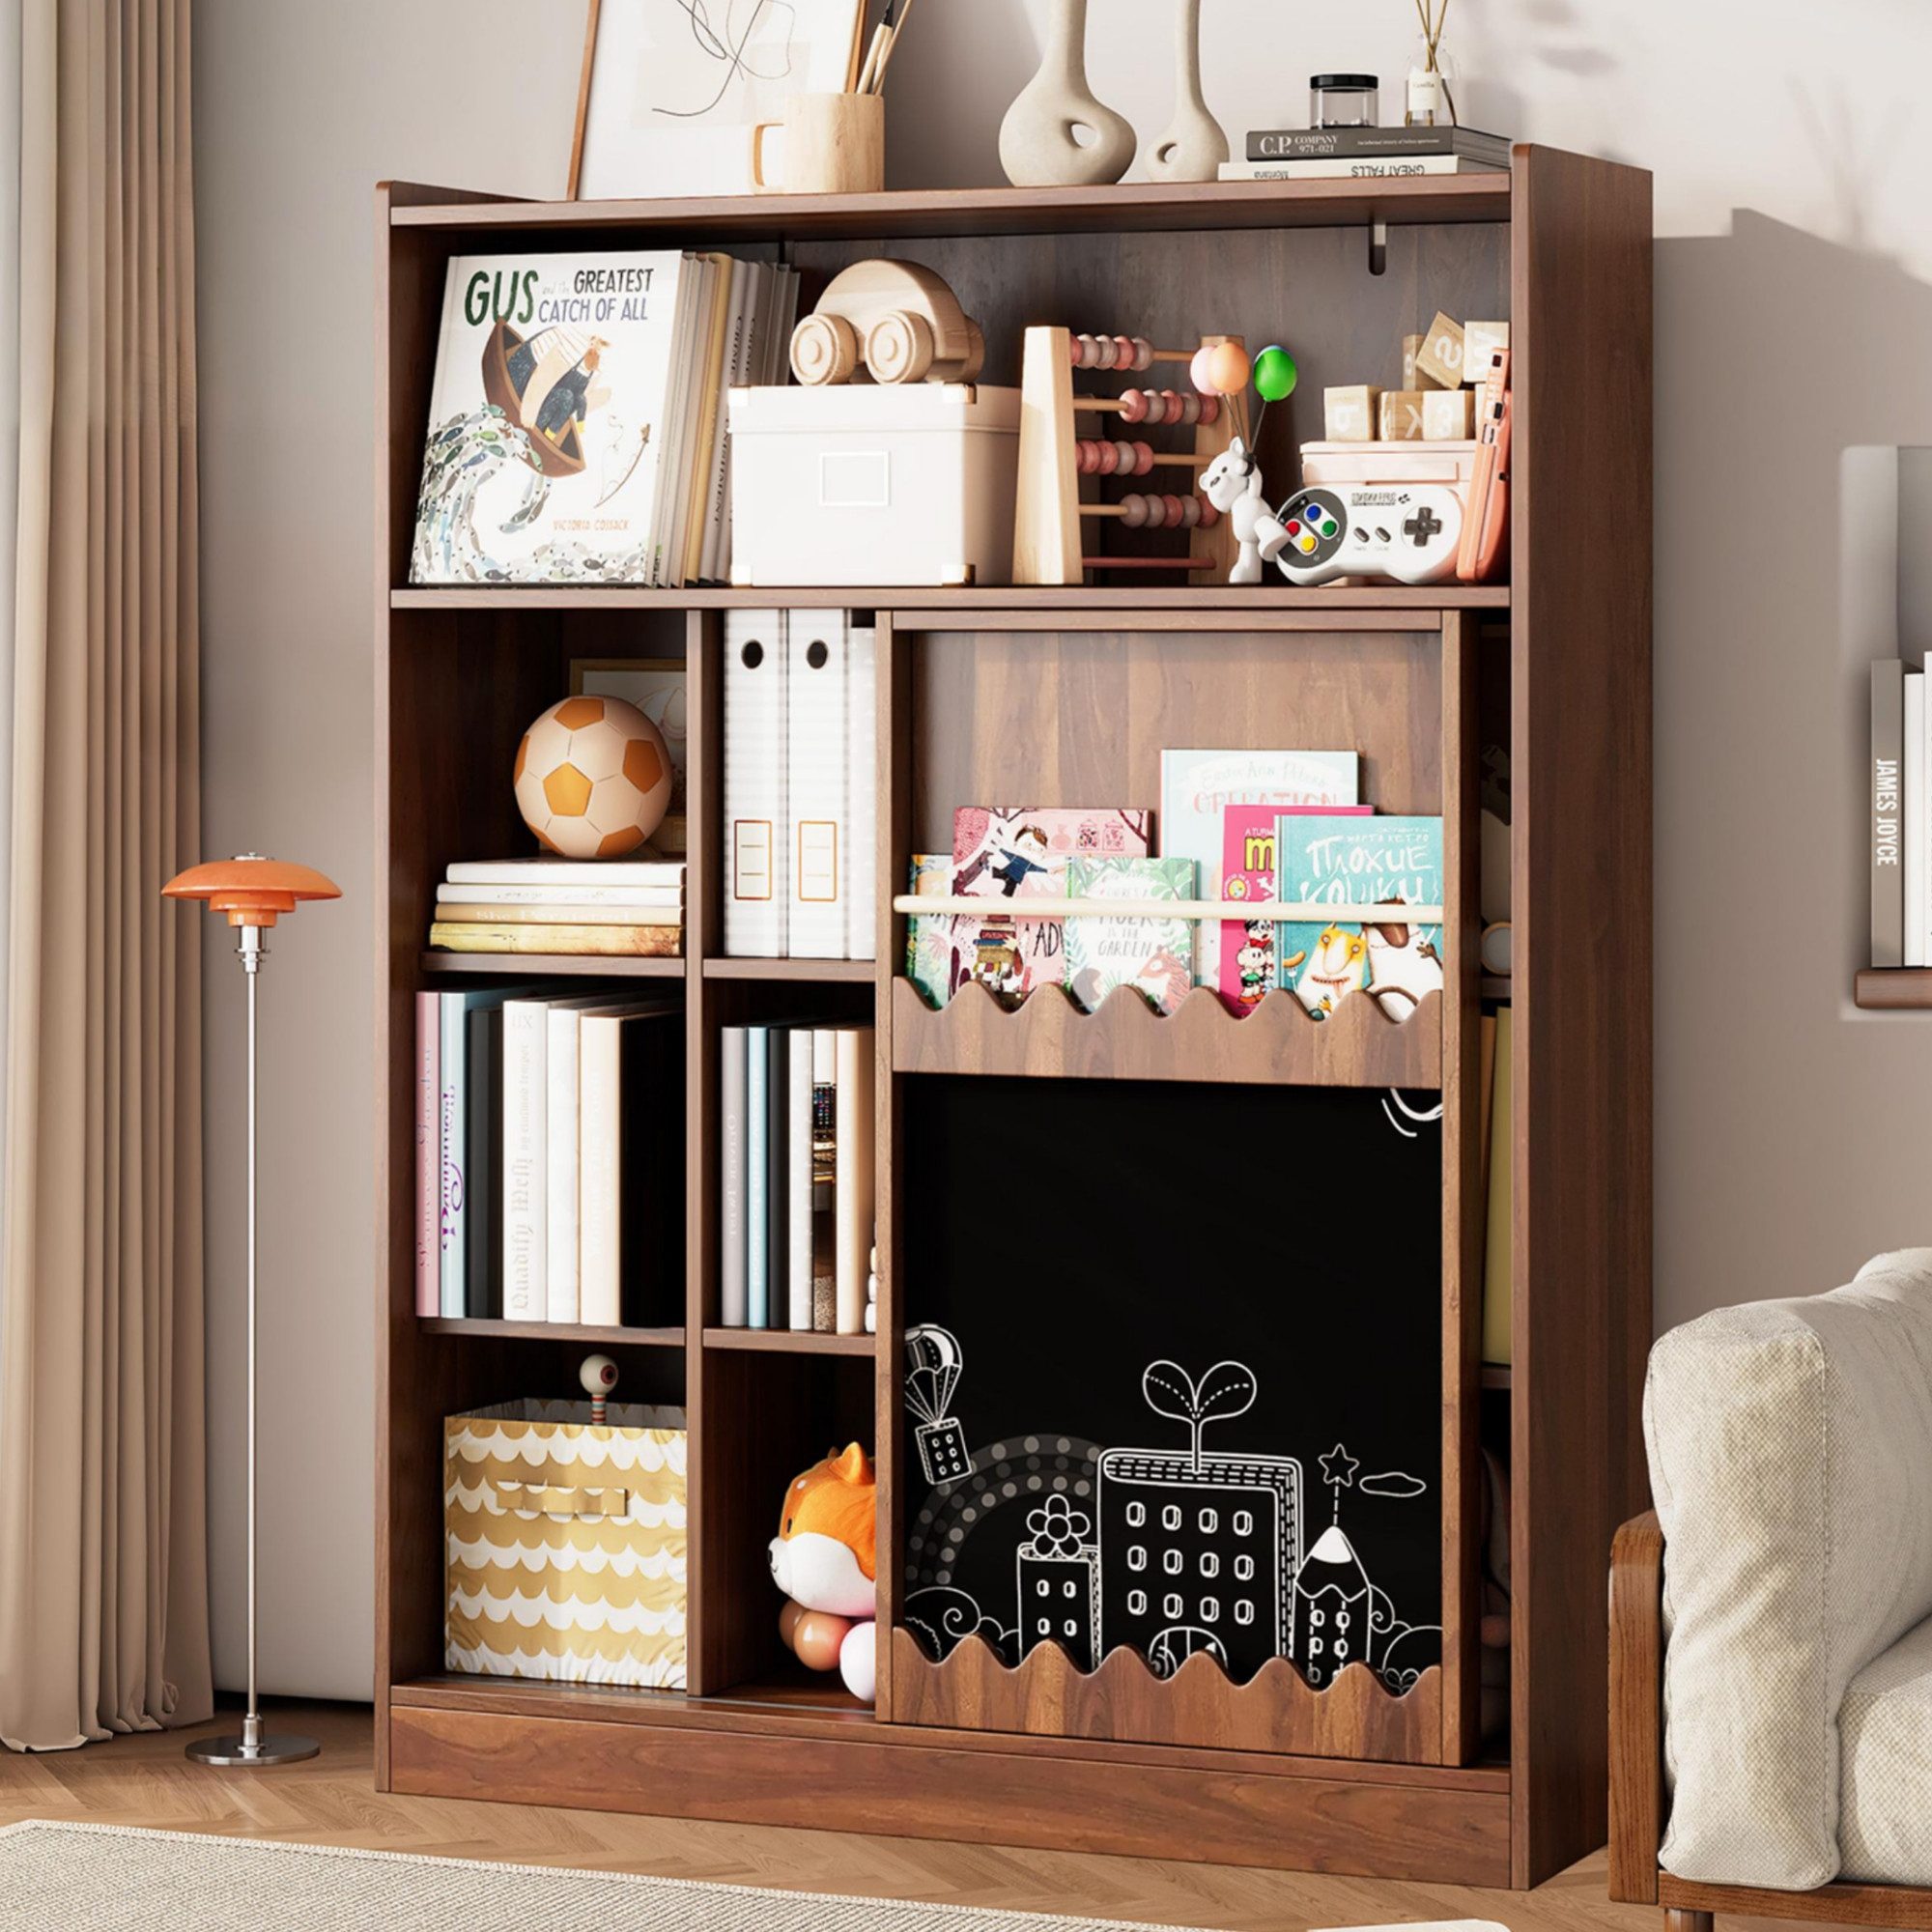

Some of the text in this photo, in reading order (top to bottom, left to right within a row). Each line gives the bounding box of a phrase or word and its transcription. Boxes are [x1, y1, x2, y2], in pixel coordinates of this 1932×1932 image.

[1259, 135, 1338, 155] C.P. COMPANY
[1350, 163, 1425, 178] GREAT FALLS
[574, 268, 655, 295] GREATEST
[464, 270, 539, 327] GUS
[538, 297, 648, 324] CATCH OF ALL
[1876, 758, 1898, 866] JAMES JOYCE
[1097, 939, 1152, 957] GARDEN
